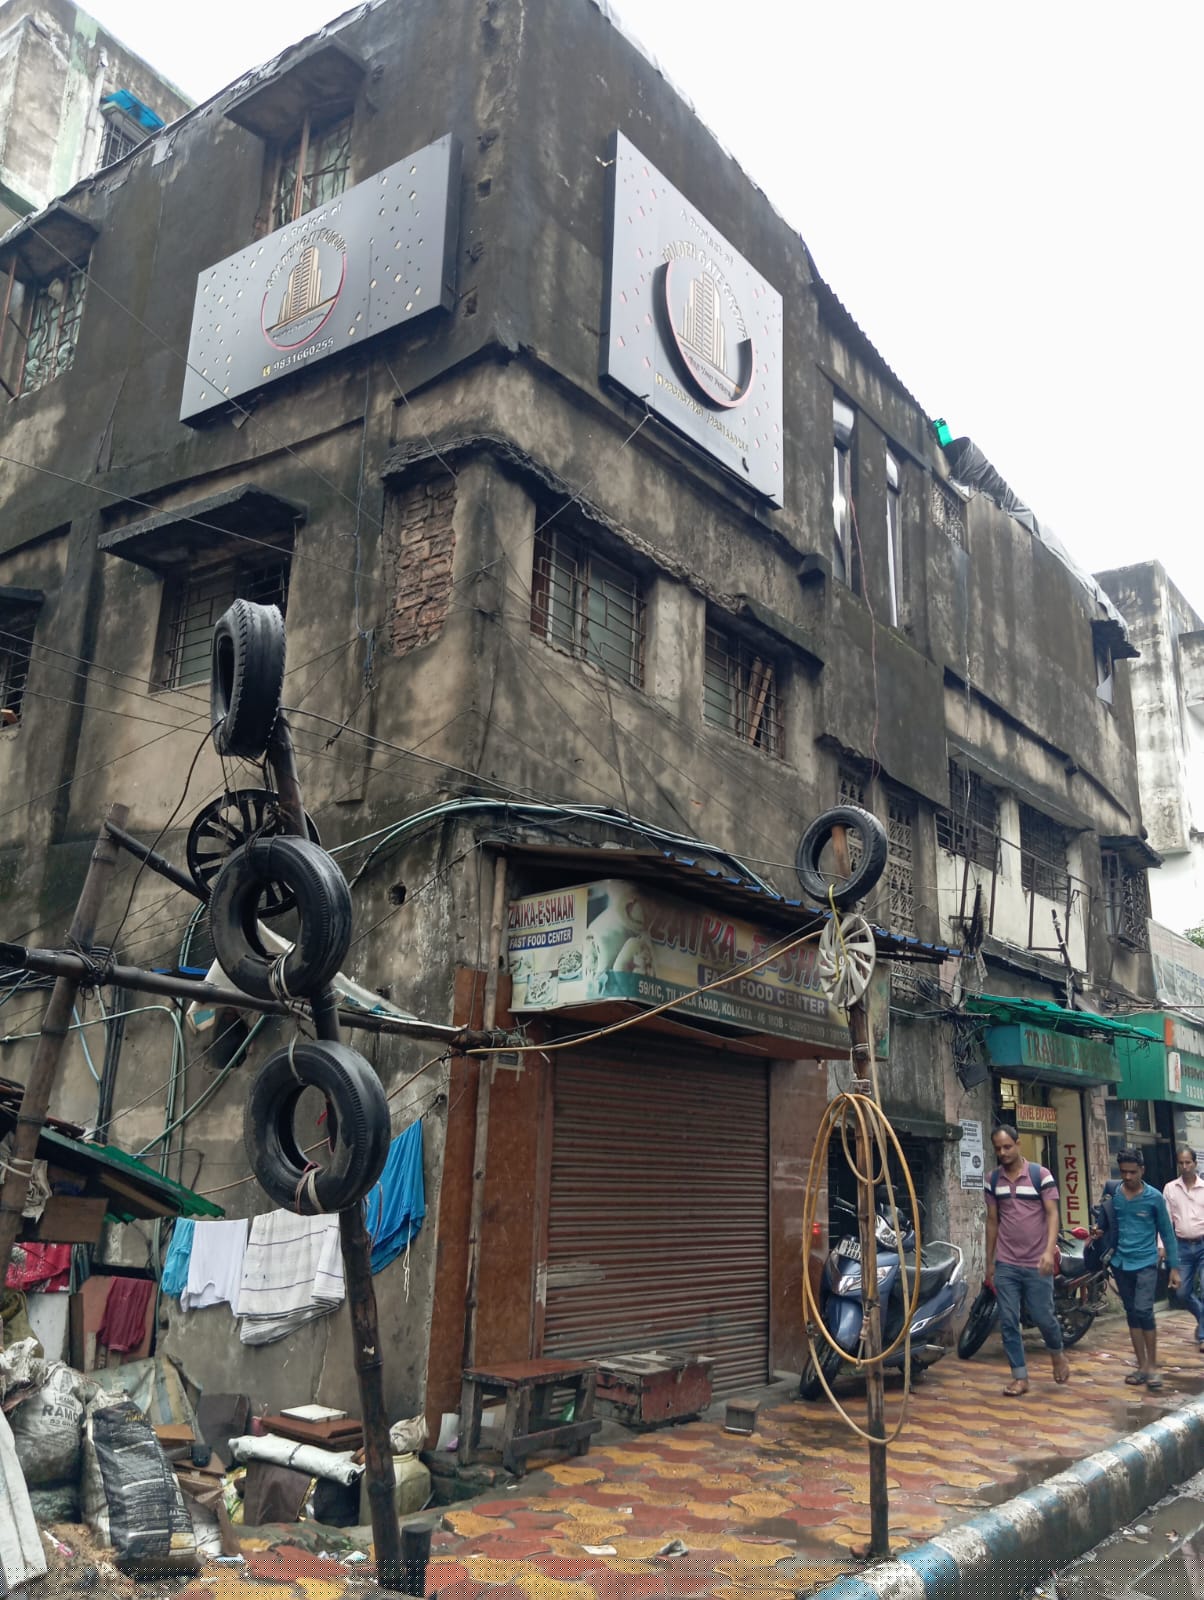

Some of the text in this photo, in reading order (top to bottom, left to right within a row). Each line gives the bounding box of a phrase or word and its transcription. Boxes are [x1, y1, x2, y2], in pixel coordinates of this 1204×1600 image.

[273, 336, 334, 371] 9831660255
[508, 894, 575, 929] ZAIKA-E-SHAAN
[509, 928, 572, 949] FAST FOOD CENTER
[721, 1001, 753, 1020] KOLKATA
[739, 980, 774, 1001] FOOD
[777, 990, 825, 1015] CENTER
[1064, 1144, 1080, 1225] TRAVEL
